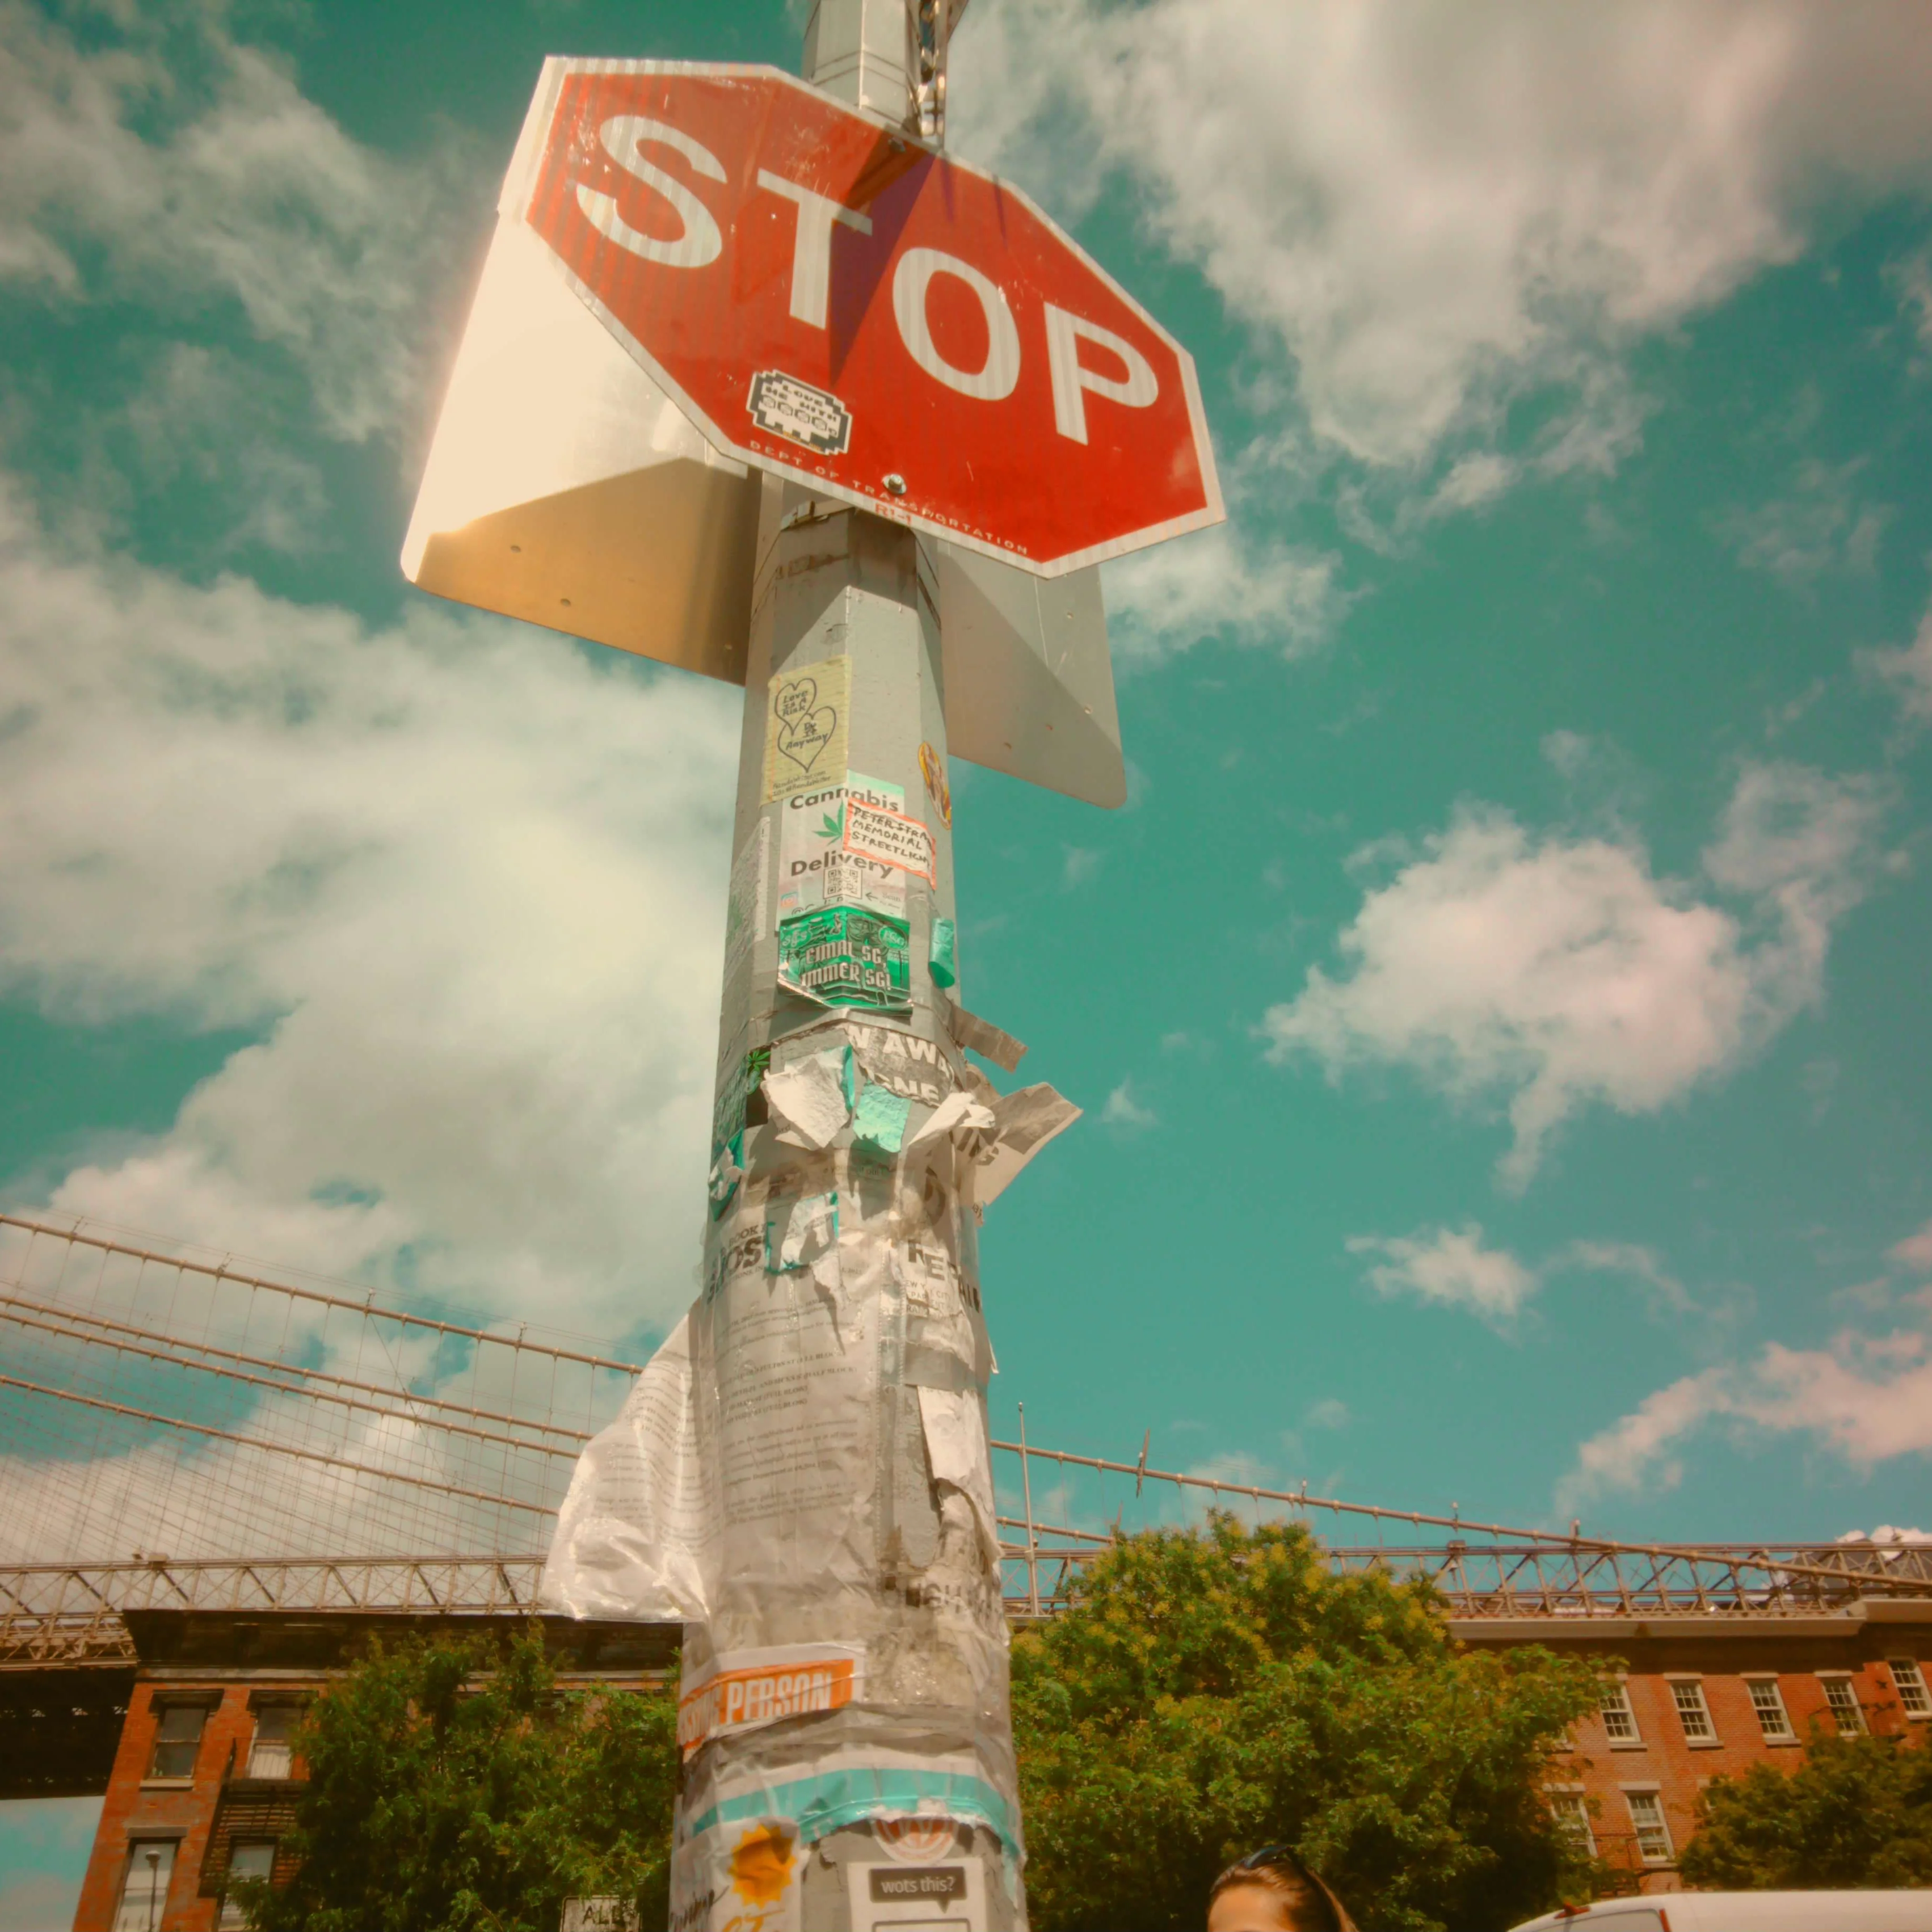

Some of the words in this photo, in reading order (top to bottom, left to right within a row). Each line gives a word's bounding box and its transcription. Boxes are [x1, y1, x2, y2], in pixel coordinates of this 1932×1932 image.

[576, 114, 1159, 445] STOP
[750, 439, 803, 465] DEPT
[815, 465, 840, 478] OF
[852, 479, 1028, 555] TRANSPORTATION
[874, 502, 912, 526] R1-1
[783, 690, 808, 703] Love
[790, 787, 899, 812] Cannabis
[853, 807, 894, 829] PETER
[852, 819, 922, 850] MEMORIAL
[790, 850, 893, 879] Delivery
[801, 962, 861, 989] IMMER
[865, 969, 892, 991] SG!
[725, 1672, 831, 1725] PERSON
[880, 1878, 918, 1894] wots
[920, 1876, 955, 1893] this?
